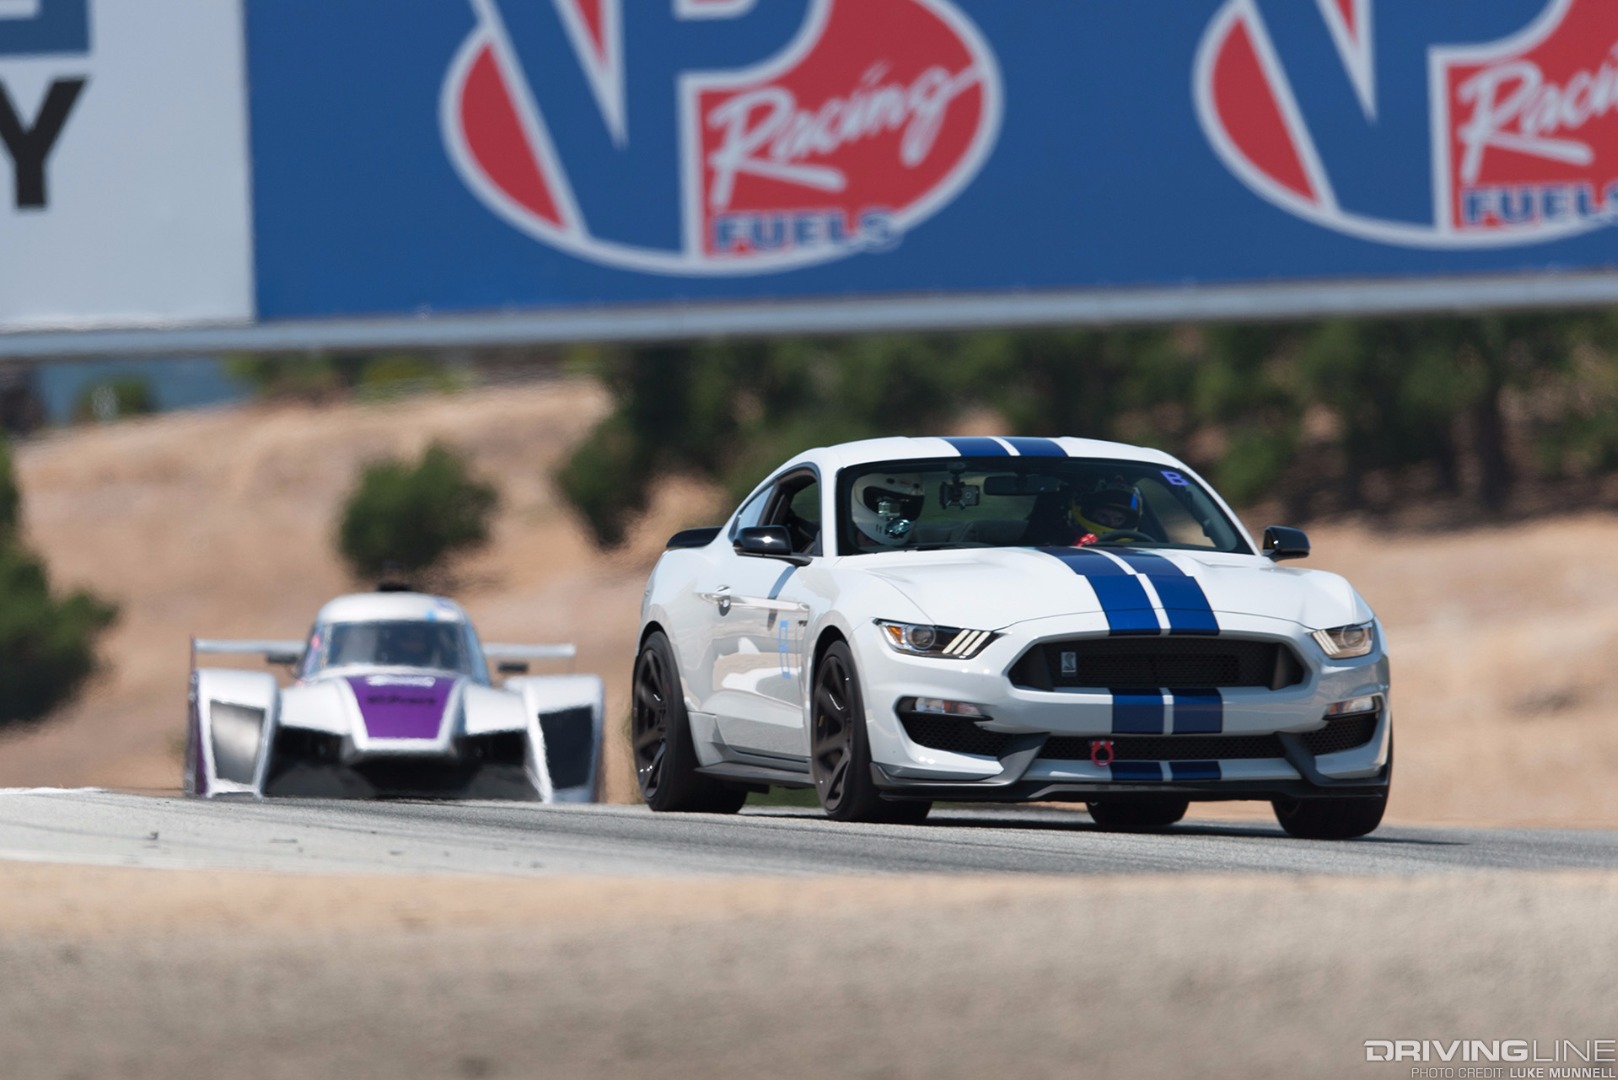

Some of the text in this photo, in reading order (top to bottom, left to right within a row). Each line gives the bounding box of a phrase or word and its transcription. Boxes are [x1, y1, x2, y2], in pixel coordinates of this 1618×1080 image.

[707, 60, 978, 210] Racing
[1457, 58, 1618, 184] Raci
[714, 208, 900, 250] FUELS
[1463, 182, 1618, 226] FUEL
